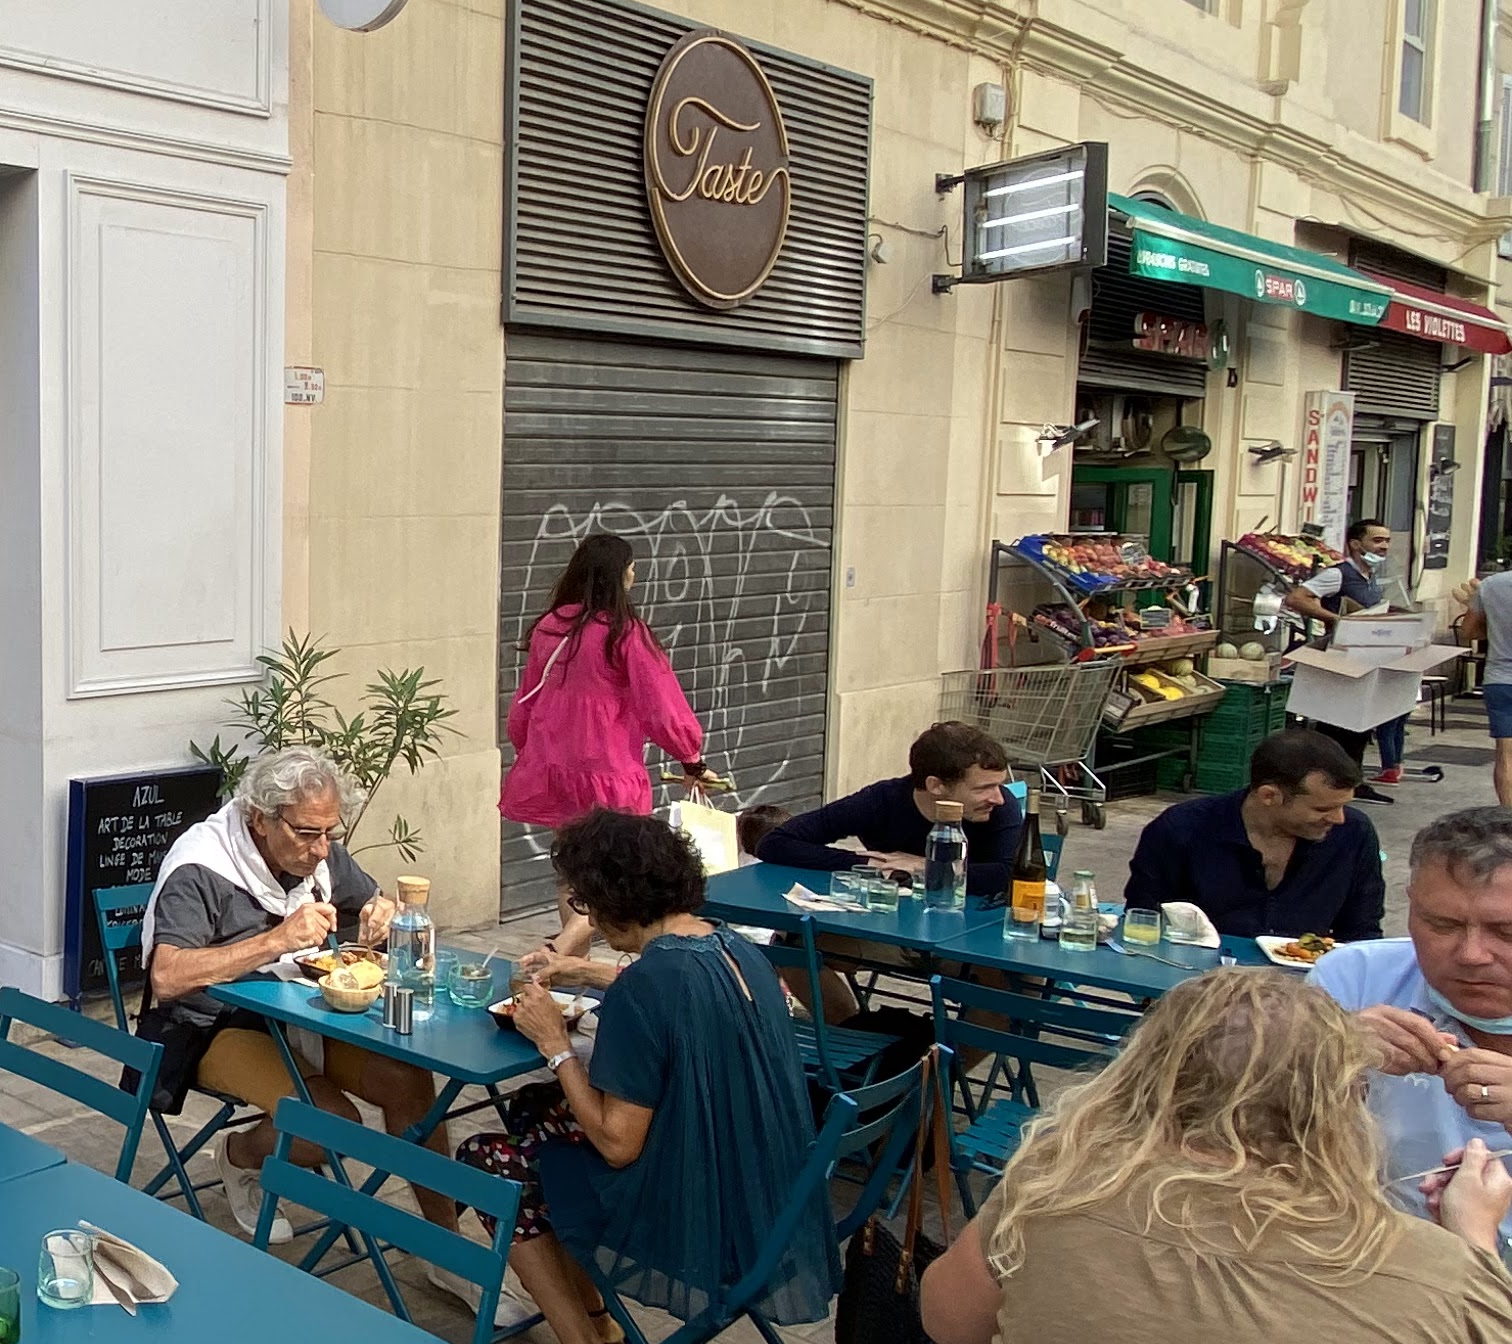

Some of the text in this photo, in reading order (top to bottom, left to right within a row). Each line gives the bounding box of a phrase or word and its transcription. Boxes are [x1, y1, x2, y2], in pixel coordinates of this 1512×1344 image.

[668, 96, 784, 204] Taste
[1265, 278, 1294, 299] SPAR
[1406, 309, 1466, 343] LES VIOLETTES
[1303, 409, 1321, 522] SANDWI
[132, 784, 165, 807] AZUL
[97, 811, 183, 834] ART DE LA TABLE
[130, 852, 144, 866] DE
[125, 867, 152, 883] MODE
